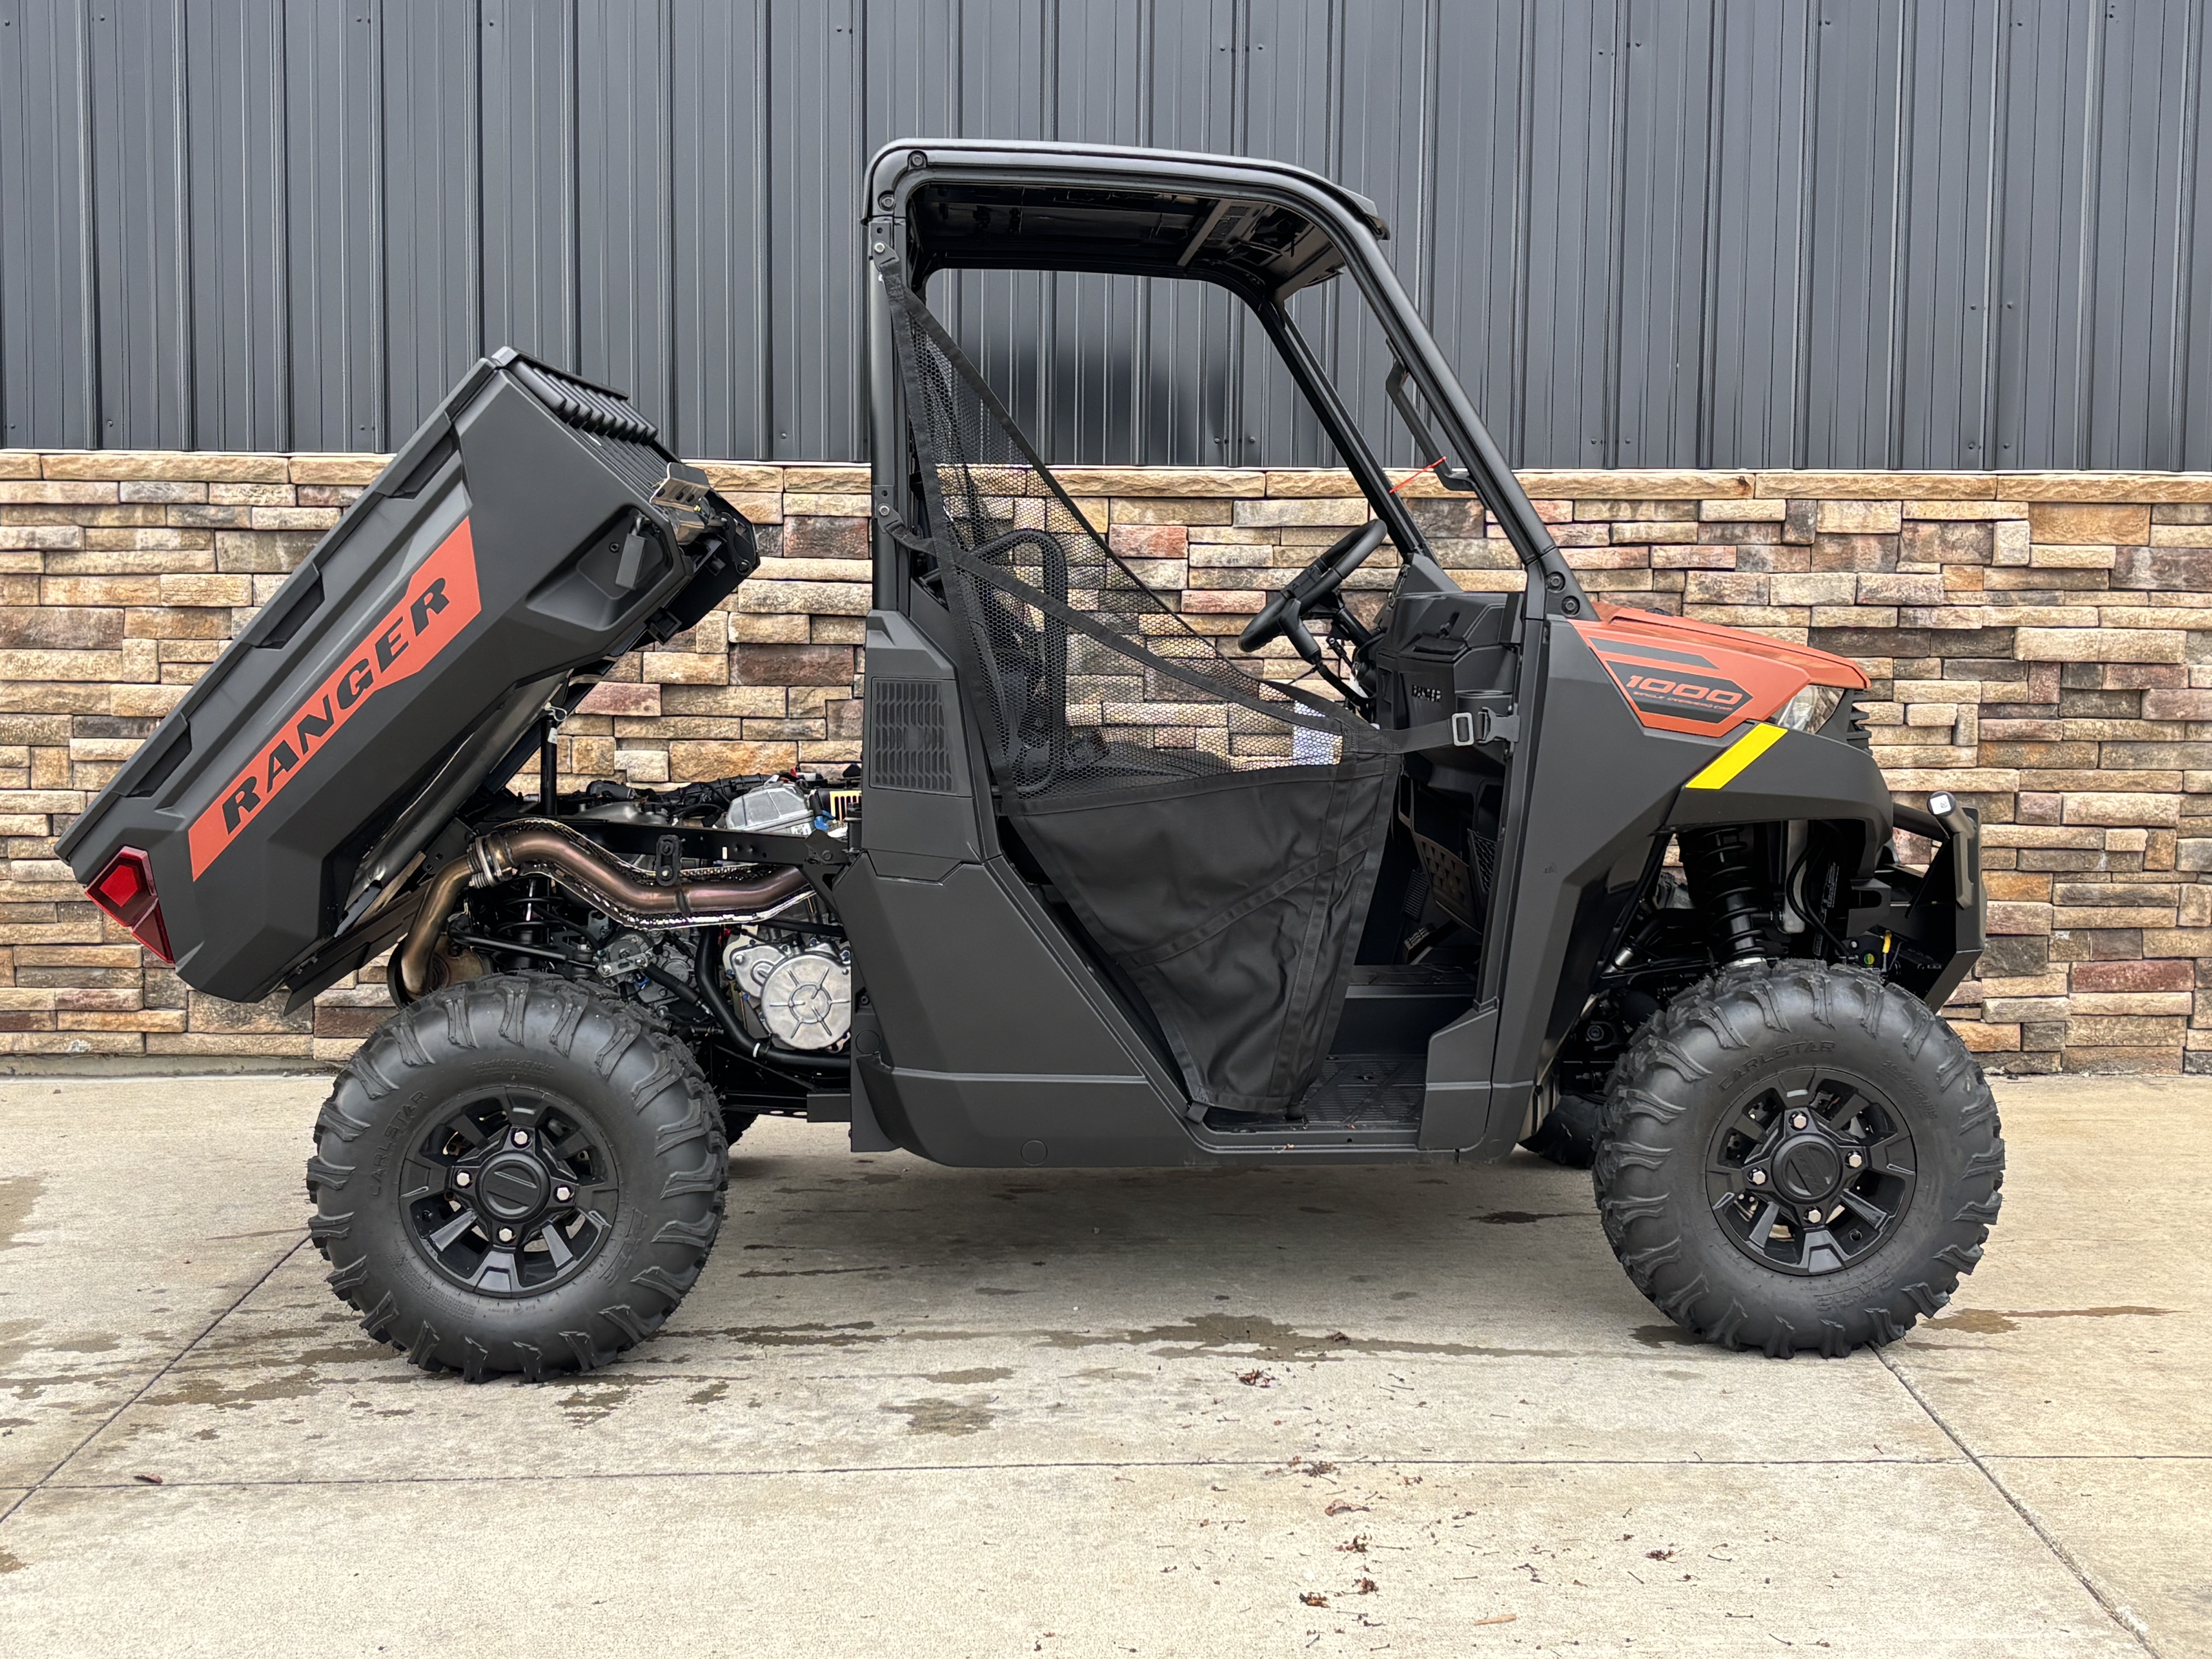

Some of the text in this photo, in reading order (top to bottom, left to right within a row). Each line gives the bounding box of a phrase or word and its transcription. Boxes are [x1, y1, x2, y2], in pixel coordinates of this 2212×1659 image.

[222, 577, 450, 835] RANGER
[1626, 675, 1743, 706] 1000
[1717, 1040, 1836, 1092] CARLSTAR
[369, 1089, 429, 1200] CARLSTAR
